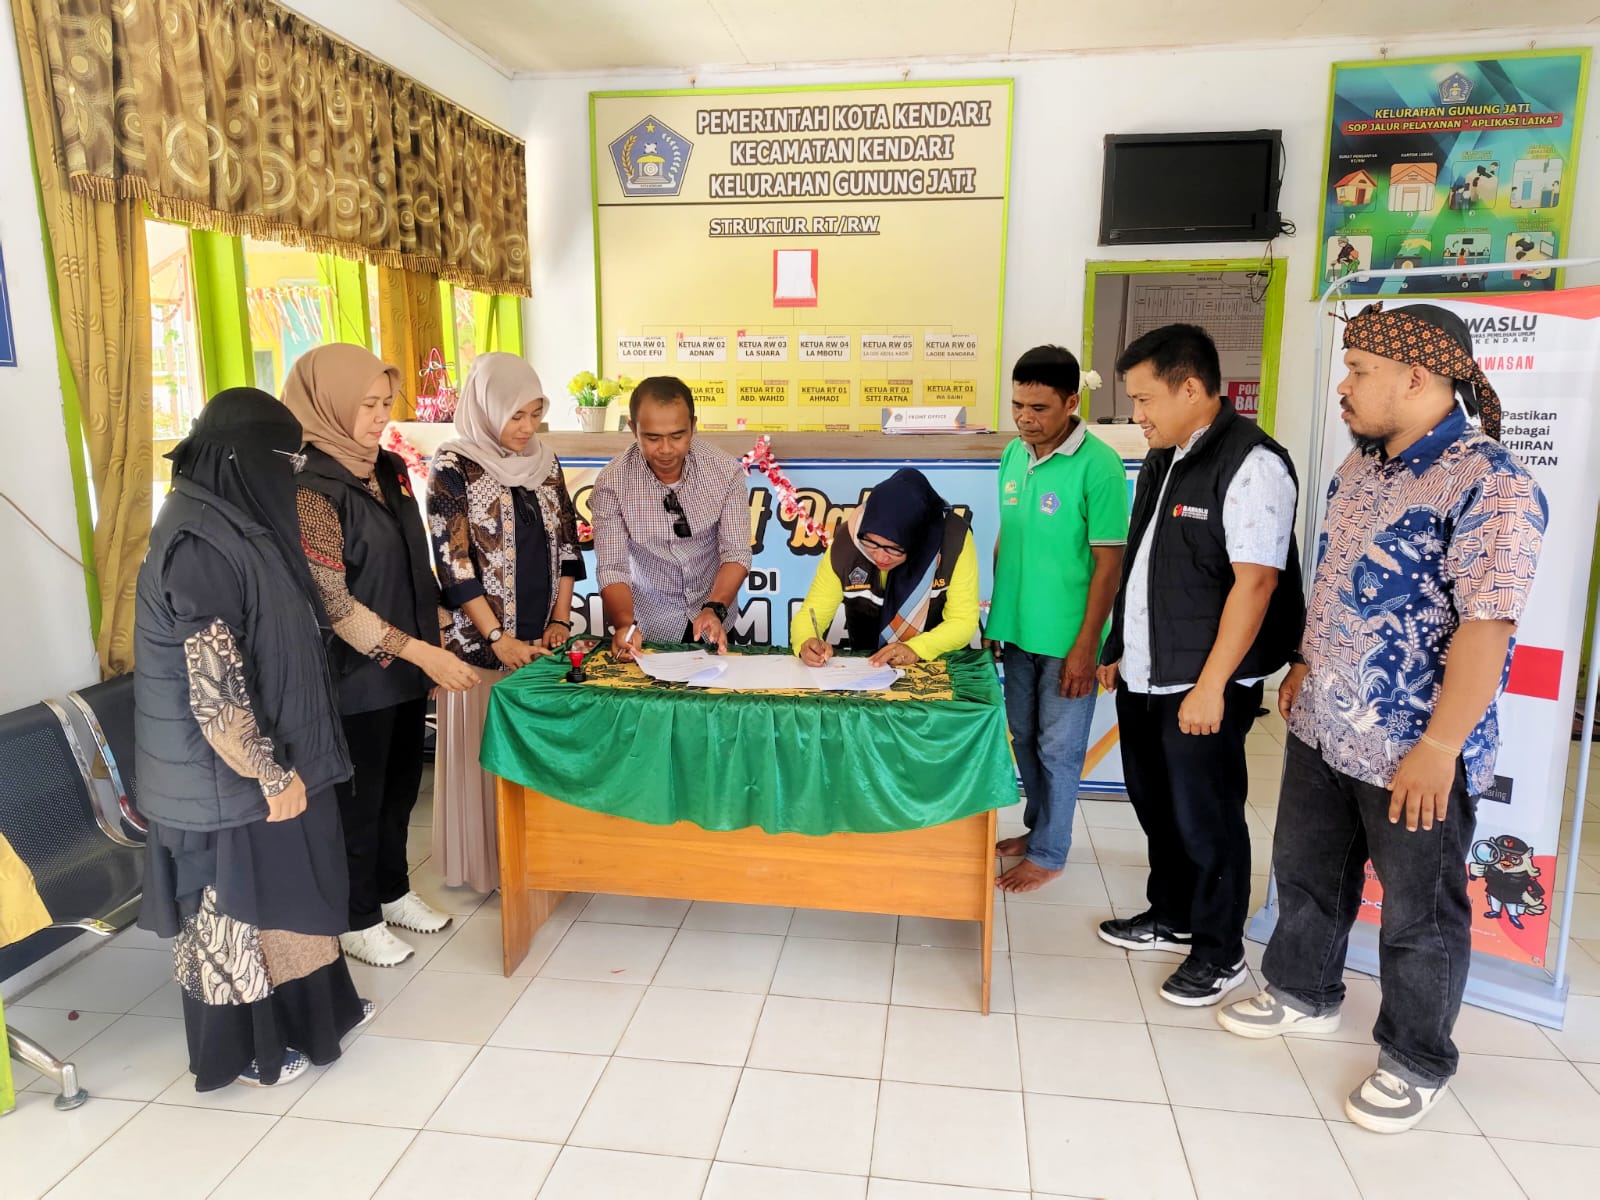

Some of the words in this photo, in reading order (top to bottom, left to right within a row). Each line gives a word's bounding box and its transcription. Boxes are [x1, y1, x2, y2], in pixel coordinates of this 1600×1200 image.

[697, 108, 829, 134] PEMERINTAH
[833, 105, 890, 130] KOTA
[893, 101, 991, 128] KENDARI
[1374, 108, 1445, 119] KELURAHAN
[1448, 105, 1500, 116] GUNUNG
[1502, 103, 1531, 114] JATI
[1347, 124, 1368, 132] SOP
[1369, 122, 1400, 131] JALUR
[1402, 119, 1461, 130] PELAYANAN
[1471, 116, 1519, 128] APLIKASI
[730, 140, 853, 165] KECAMATAN
[858, 134, 955, 162] KENDARI
[709, 173, 830, 198] KELURAHAN
[834, 170, 924, 196] GUNUNG
[926, 168, 976, 193] JATI
[709, 218, 808, 236] STRUKTUR
[811, 216, 880, 235] RT/RW
[1464, 315, 1538, 333] WASLU
[1475, 336, 1535, 344] KENDARI
[1476, 355, 1534, 371] AWASAN
[1502, 410, 1557, 420] Pastikan
[1500, 426, 1550, 438] Sebagai
[1502, 441, 1553, 450] KHIRAN
[1516, 456, 1558, 466] UTAN
[748, 571, 777, 592] DI
